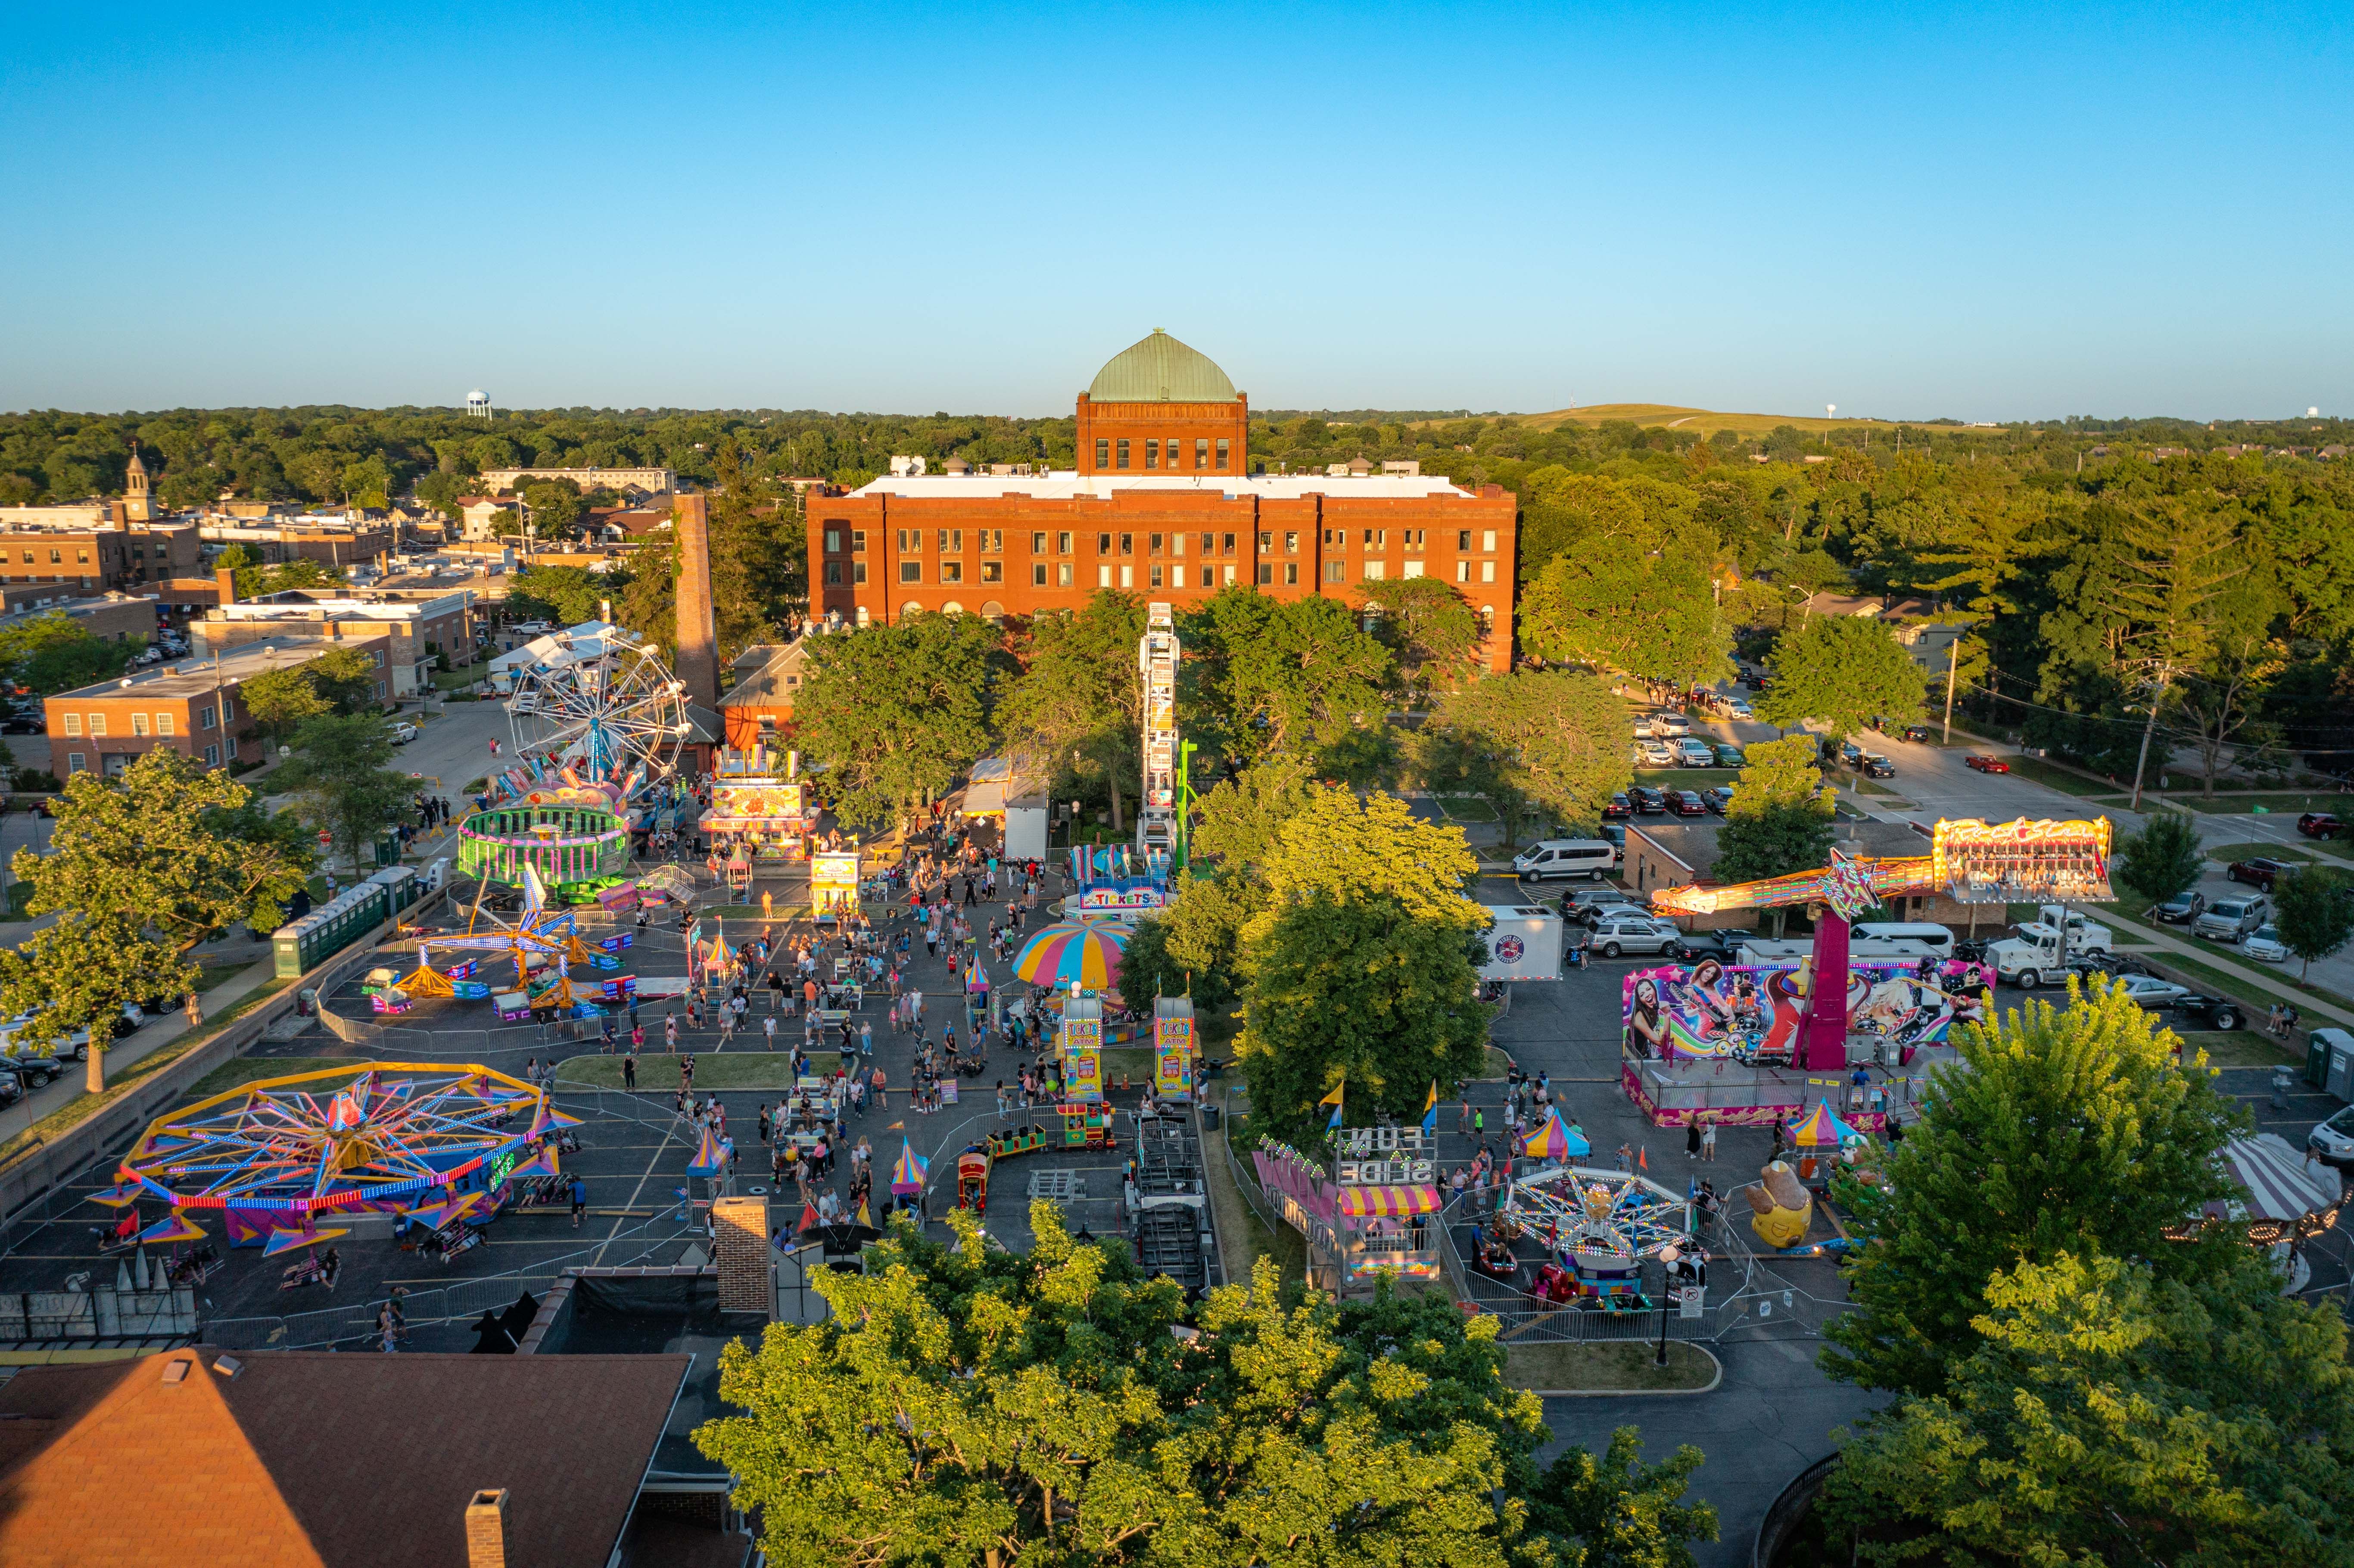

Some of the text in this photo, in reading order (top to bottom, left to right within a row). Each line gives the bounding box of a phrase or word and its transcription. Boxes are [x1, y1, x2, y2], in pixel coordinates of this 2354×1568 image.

[729, 790, 785, 809] FUNNEL CAKES
[2021, 818, 2096, 842] Star
[1096, 893, 1150, 905] TICKETS
[1498, 936, 1512, 944] WINDY
[1068, 1022, 1098, 1036] TICKETS
[1161, 1022, 1189, 1036] TICKETS
